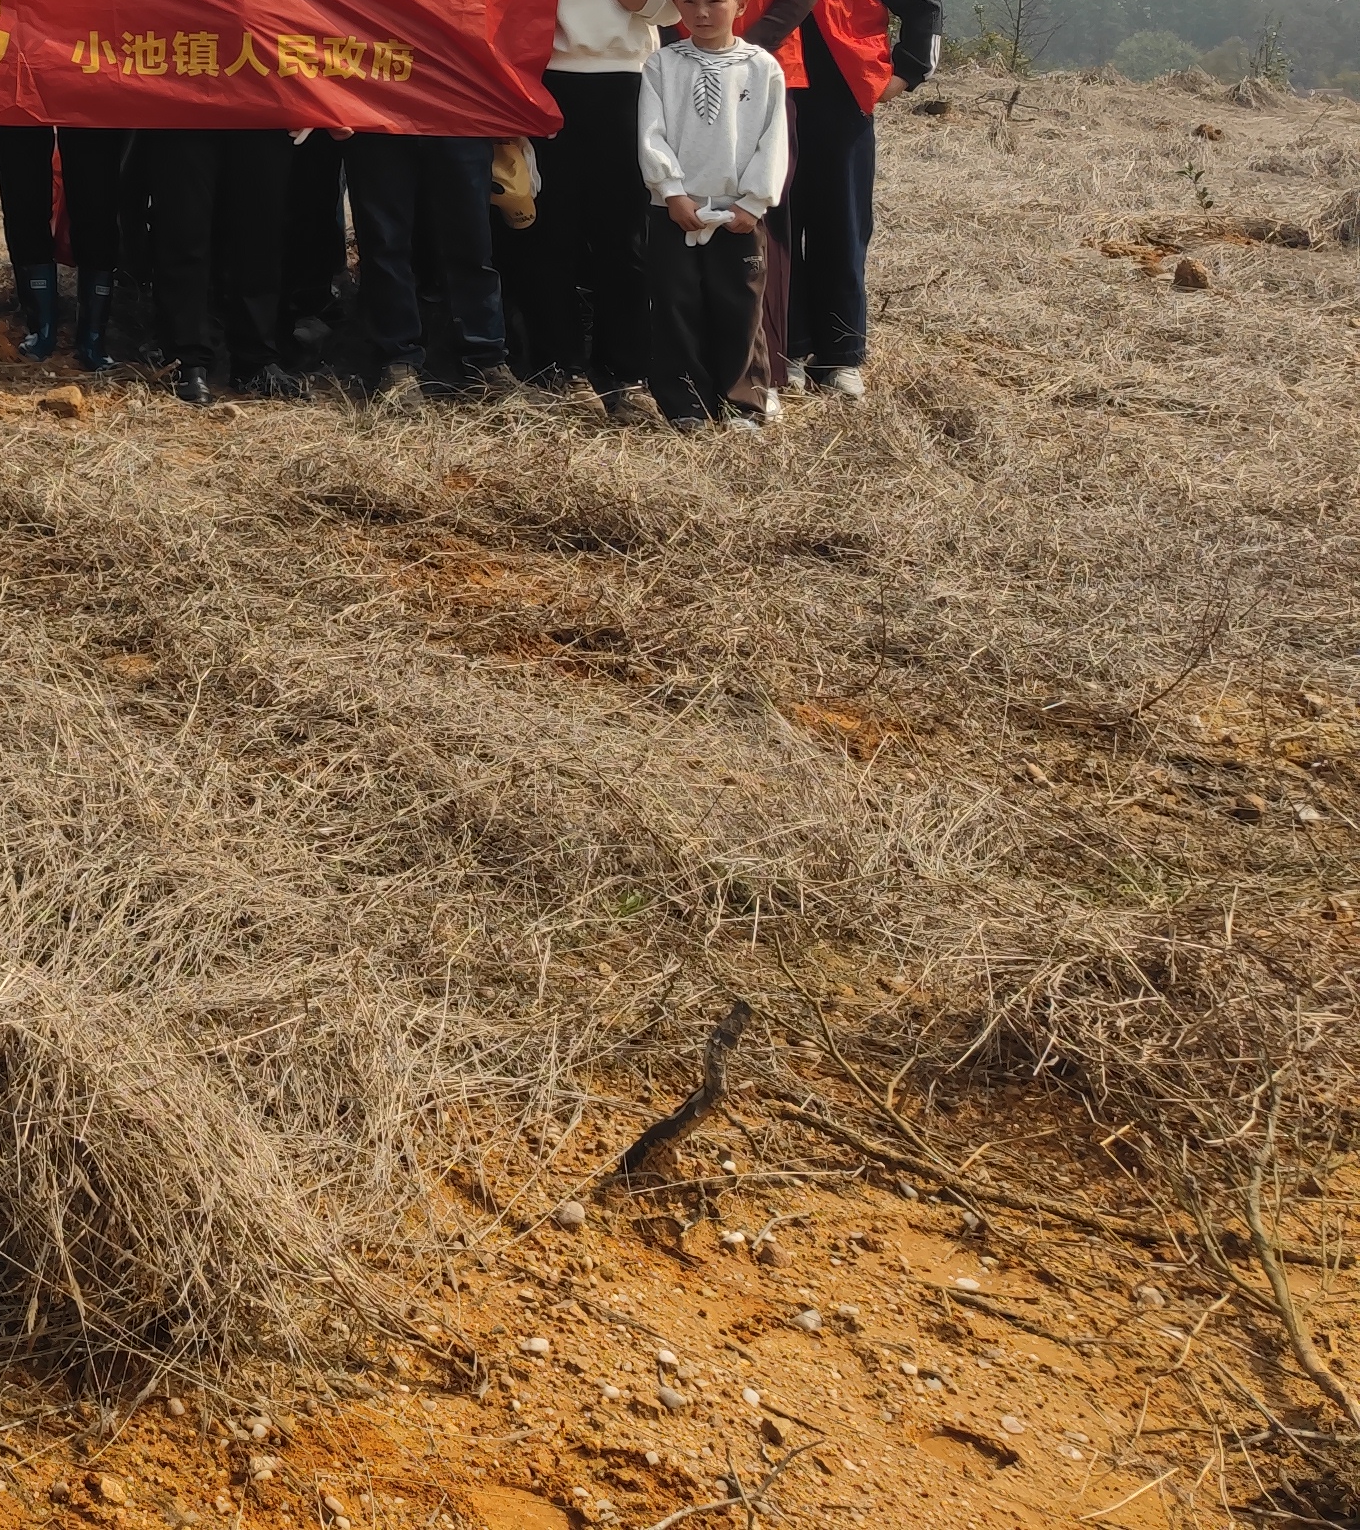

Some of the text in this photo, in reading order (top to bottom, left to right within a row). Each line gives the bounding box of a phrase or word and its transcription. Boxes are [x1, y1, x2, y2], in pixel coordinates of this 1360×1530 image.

[70, 30, 416, 83] 小池镇人民政府
